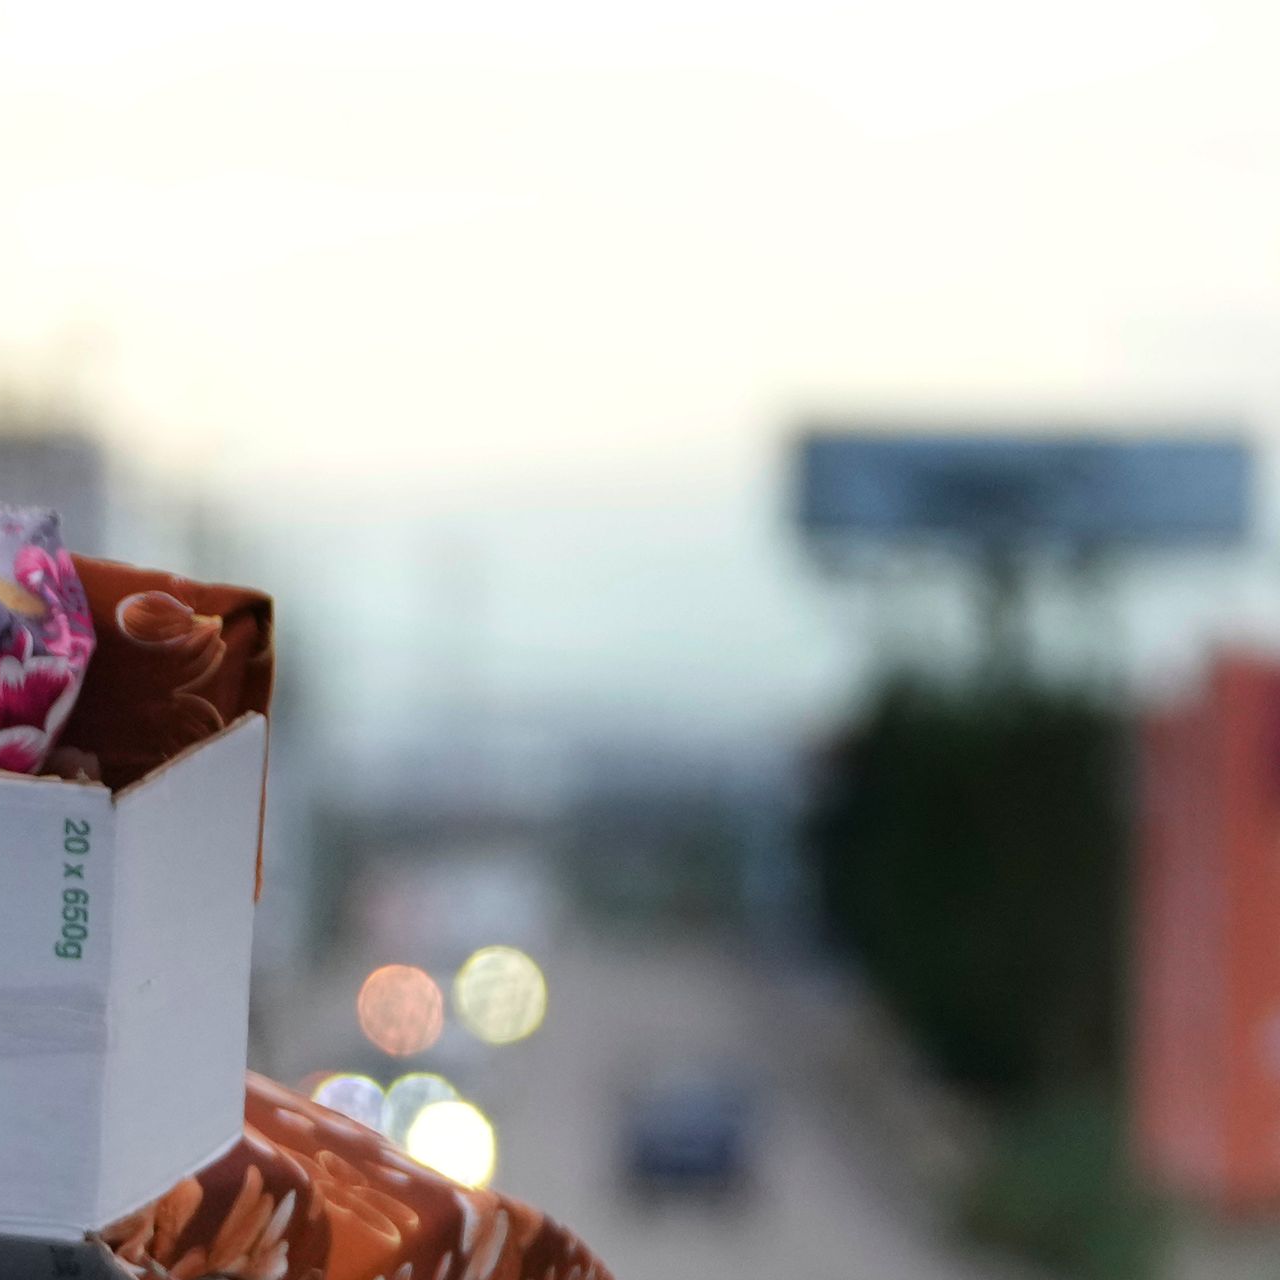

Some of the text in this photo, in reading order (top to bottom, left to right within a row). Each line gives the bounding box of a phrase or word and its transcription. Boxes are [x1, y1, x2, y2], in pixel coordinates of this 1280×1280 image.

[53, 817, 91, 962] 20 x 650g
